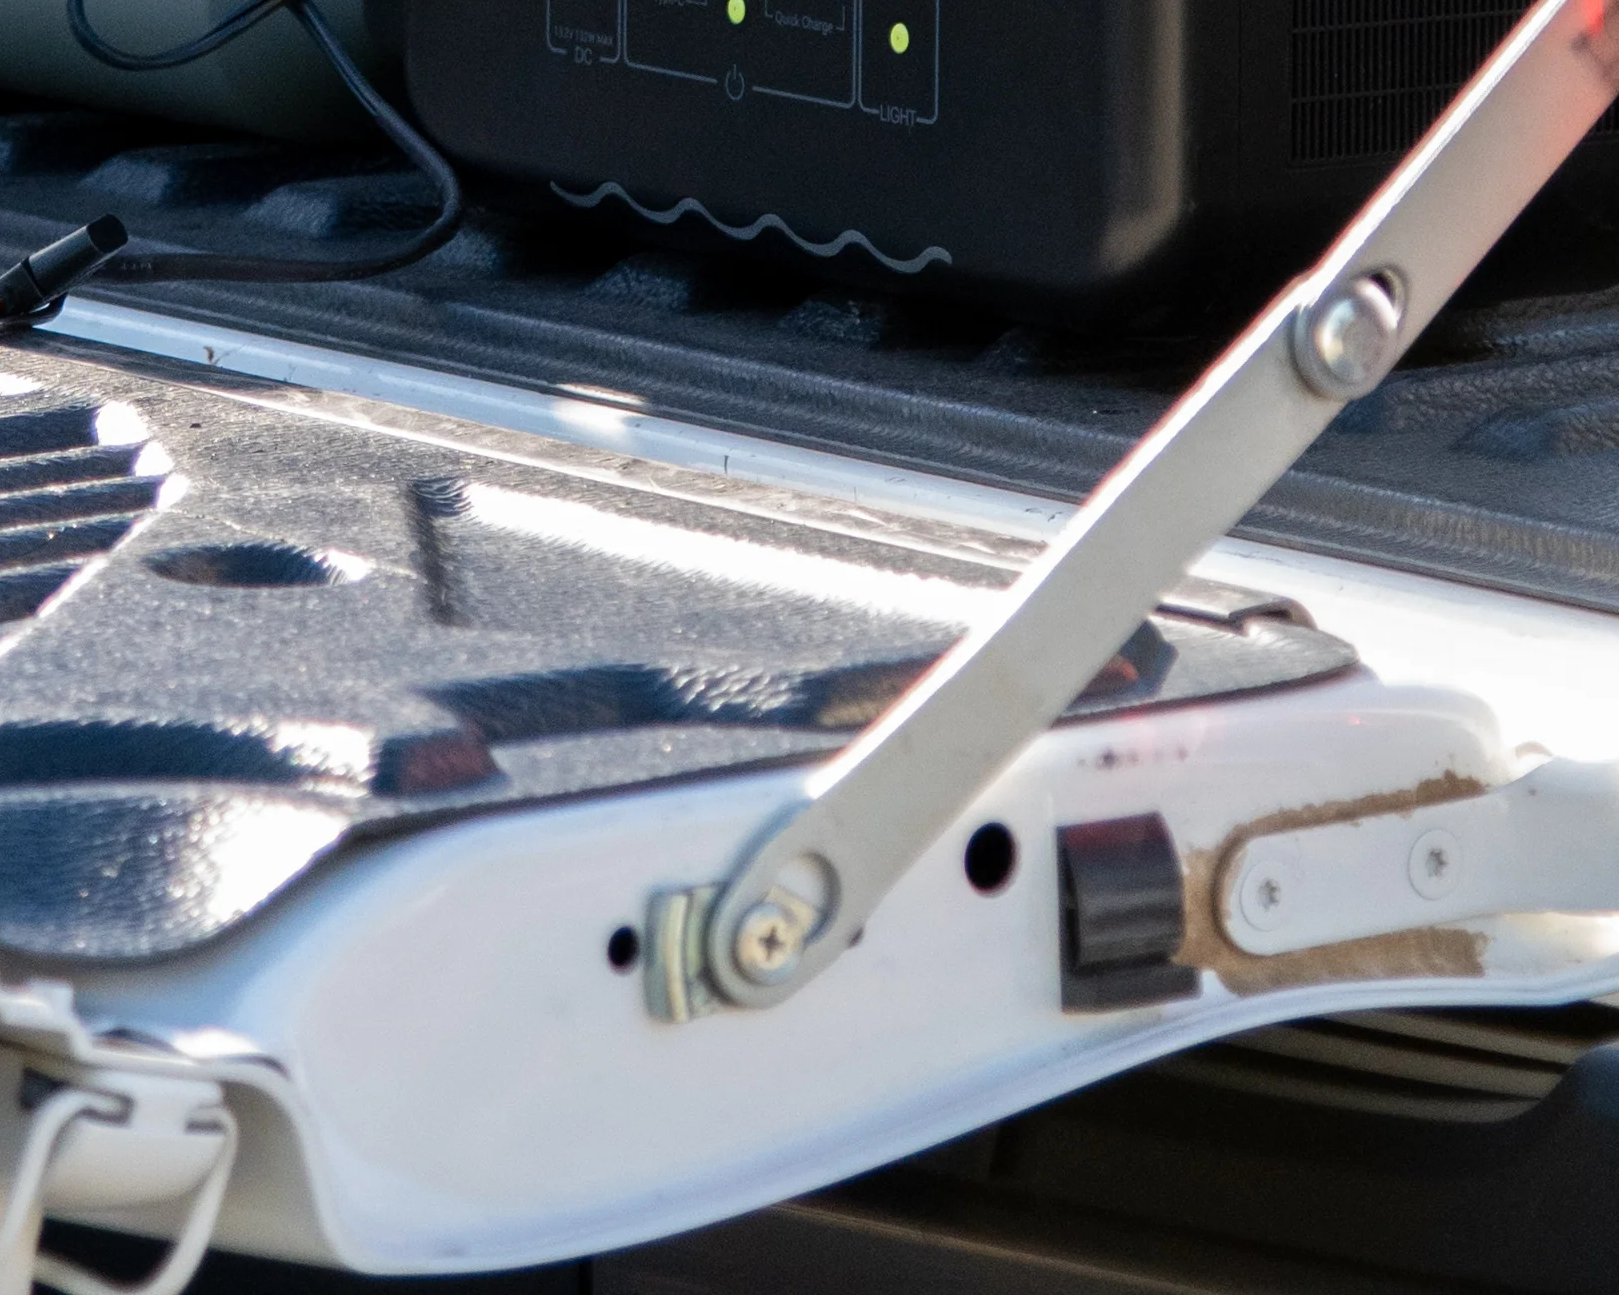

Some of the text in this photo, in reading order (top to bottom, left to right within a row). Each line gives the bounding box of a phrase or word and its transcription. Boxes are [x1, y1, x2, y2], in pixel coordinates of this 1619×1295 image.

[775, 10, 834, 37] Quick Charge
[574, 45, 593, 66] DC
[878, 103, 917, 127] LIGHT
